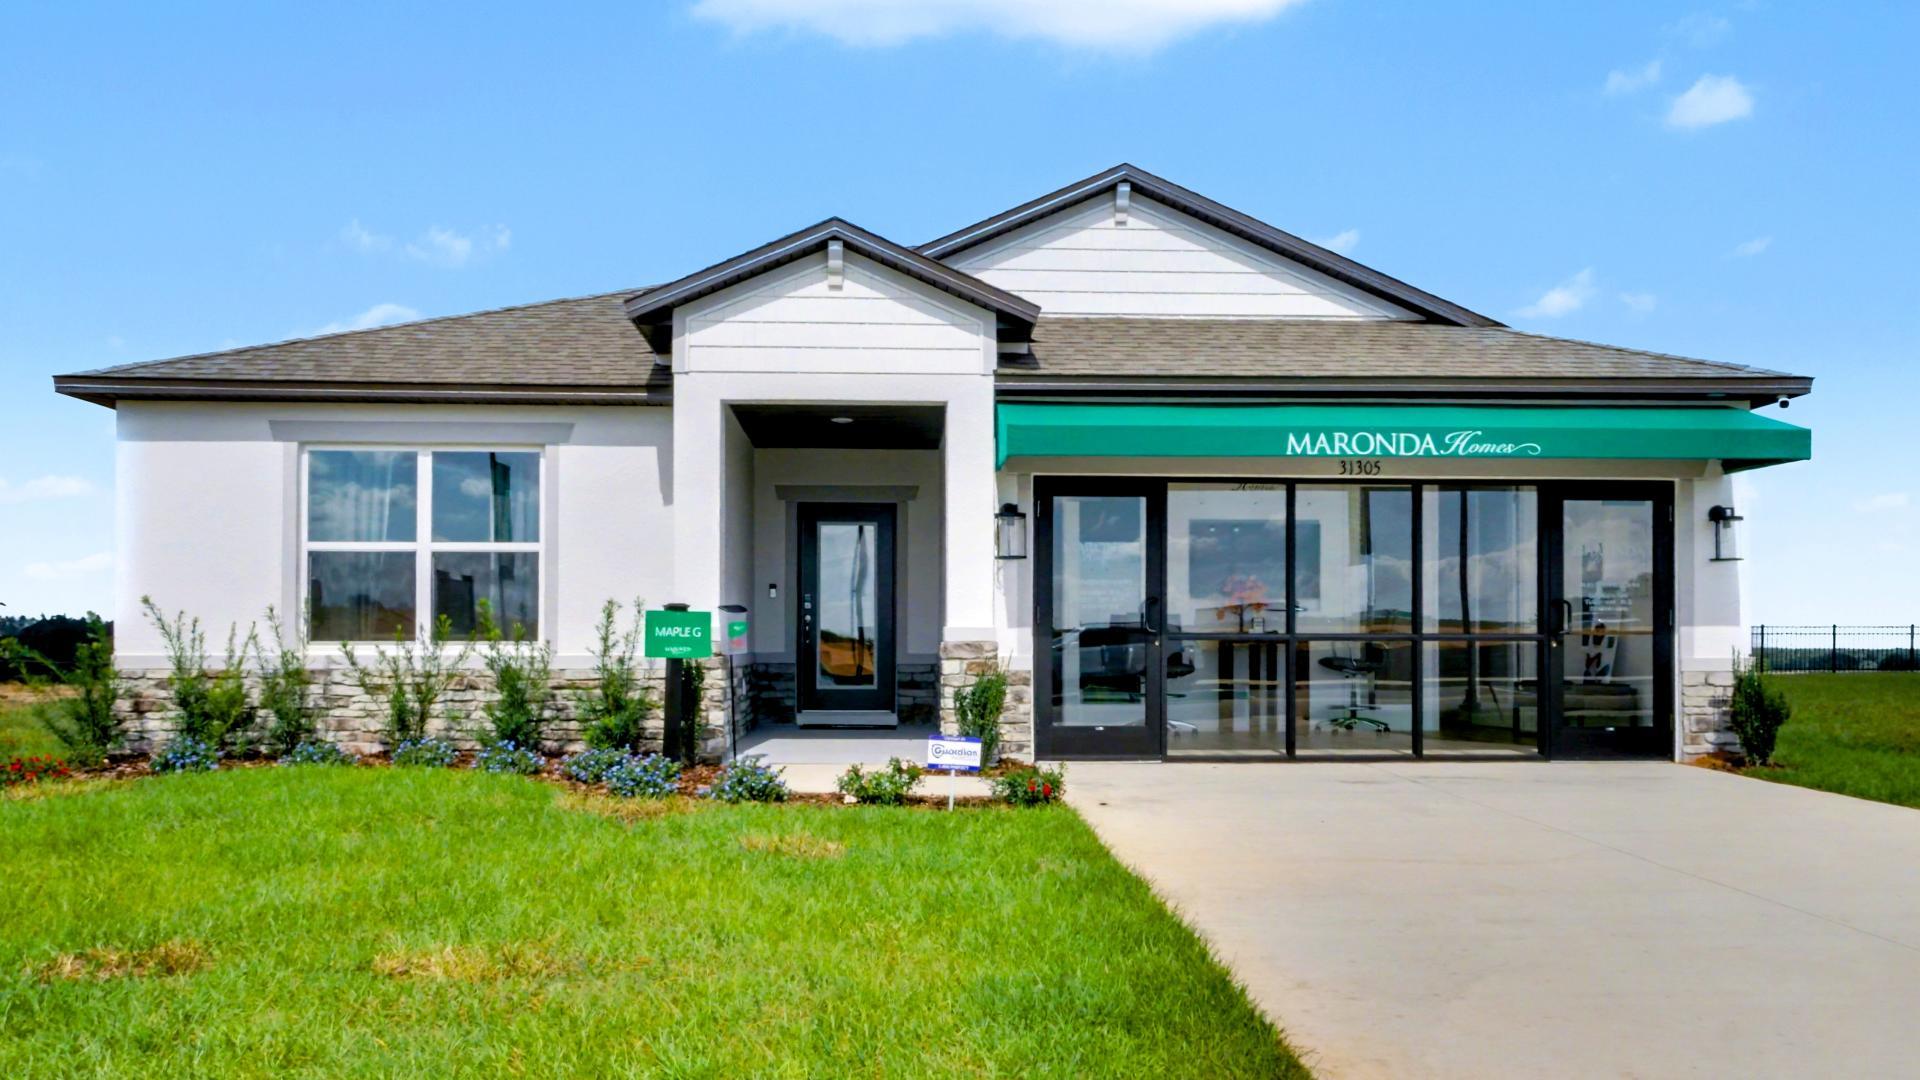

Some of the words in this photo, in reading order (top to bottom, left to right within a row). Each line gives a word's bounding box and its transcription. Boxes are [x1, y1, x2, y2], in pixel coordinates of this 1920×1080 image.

[1286, 432, 1439, 456] MARONDA
[1440, 430, 1541, 456] Homes
[1339, 460, 1381, 475] 31305
[655, 626, 691, 637] MAPLE
[692, 626, 702, 638] G
[933, 745, 978, 757] Guardian
